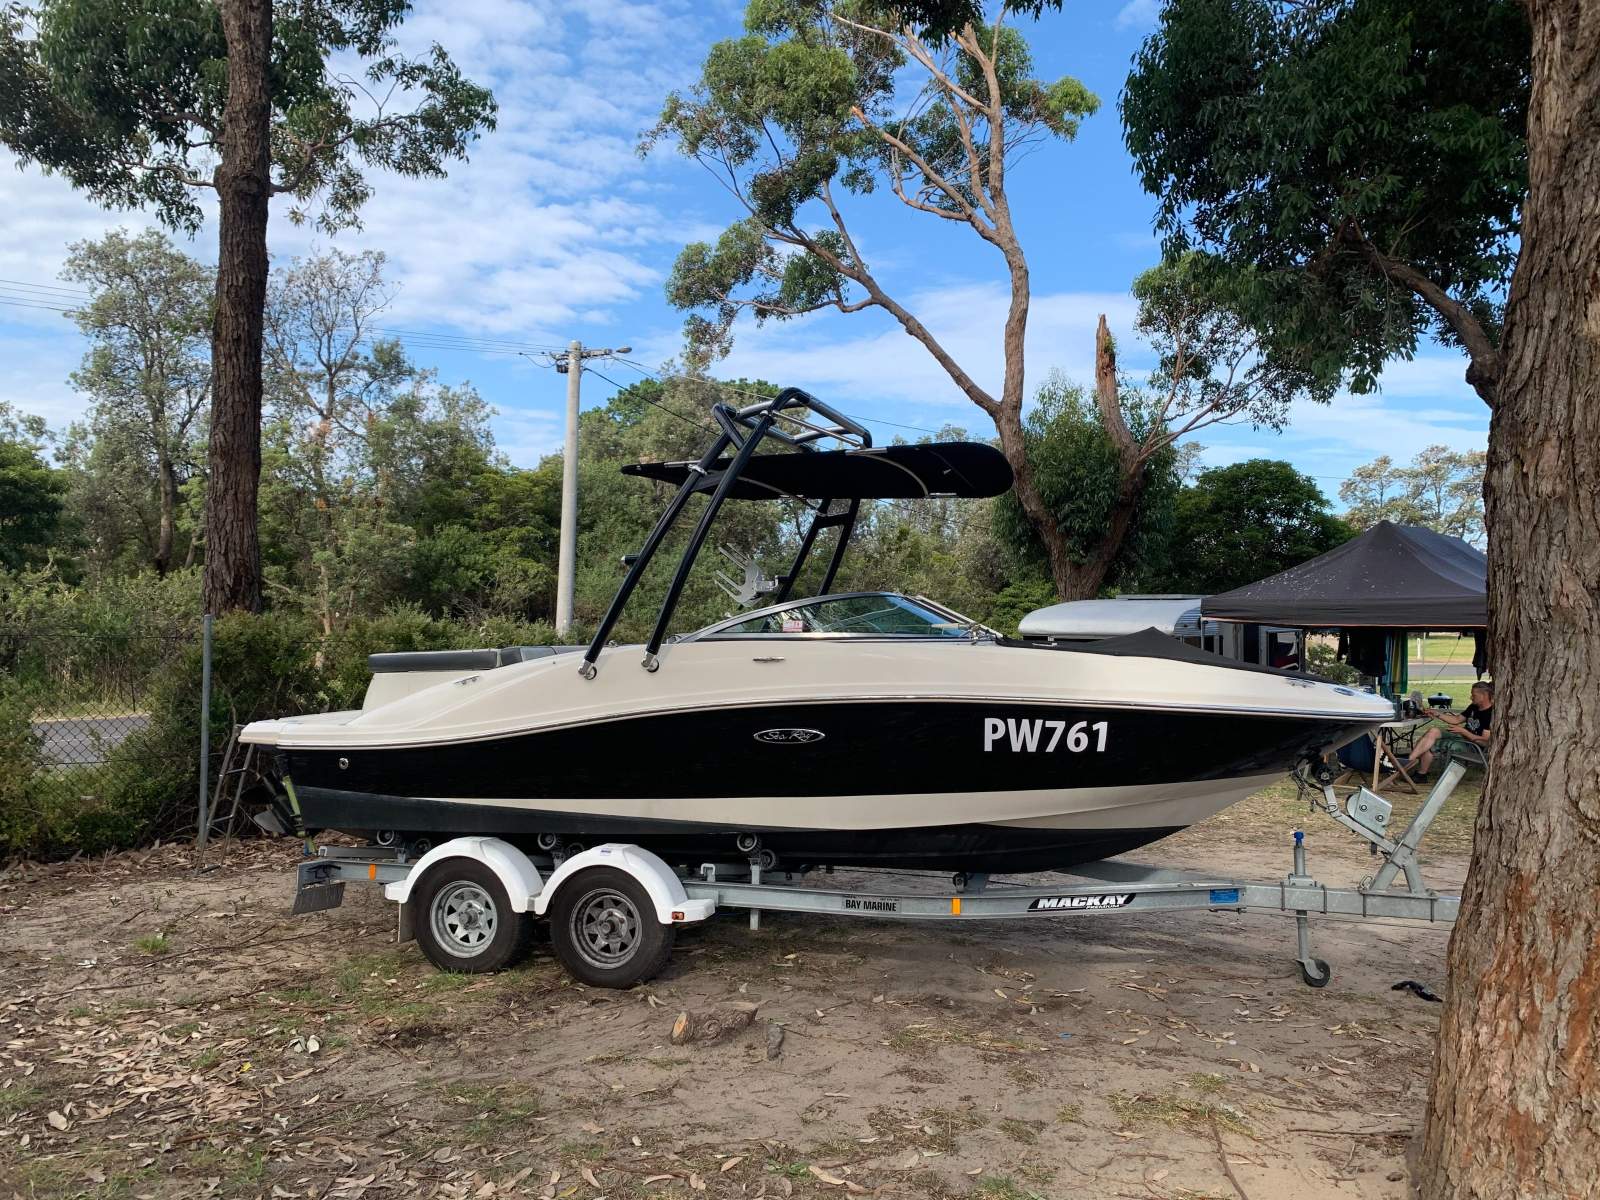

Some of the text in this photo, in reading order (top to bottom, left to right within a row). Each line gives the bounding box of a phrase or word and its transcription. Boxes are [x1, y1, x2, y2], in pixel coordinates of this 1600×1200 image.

[984, 717, 1109, 753] PW761
[845, 899, 897, 912] BAY MARINE
[1037, 894, 1130, 909] MACKAY
